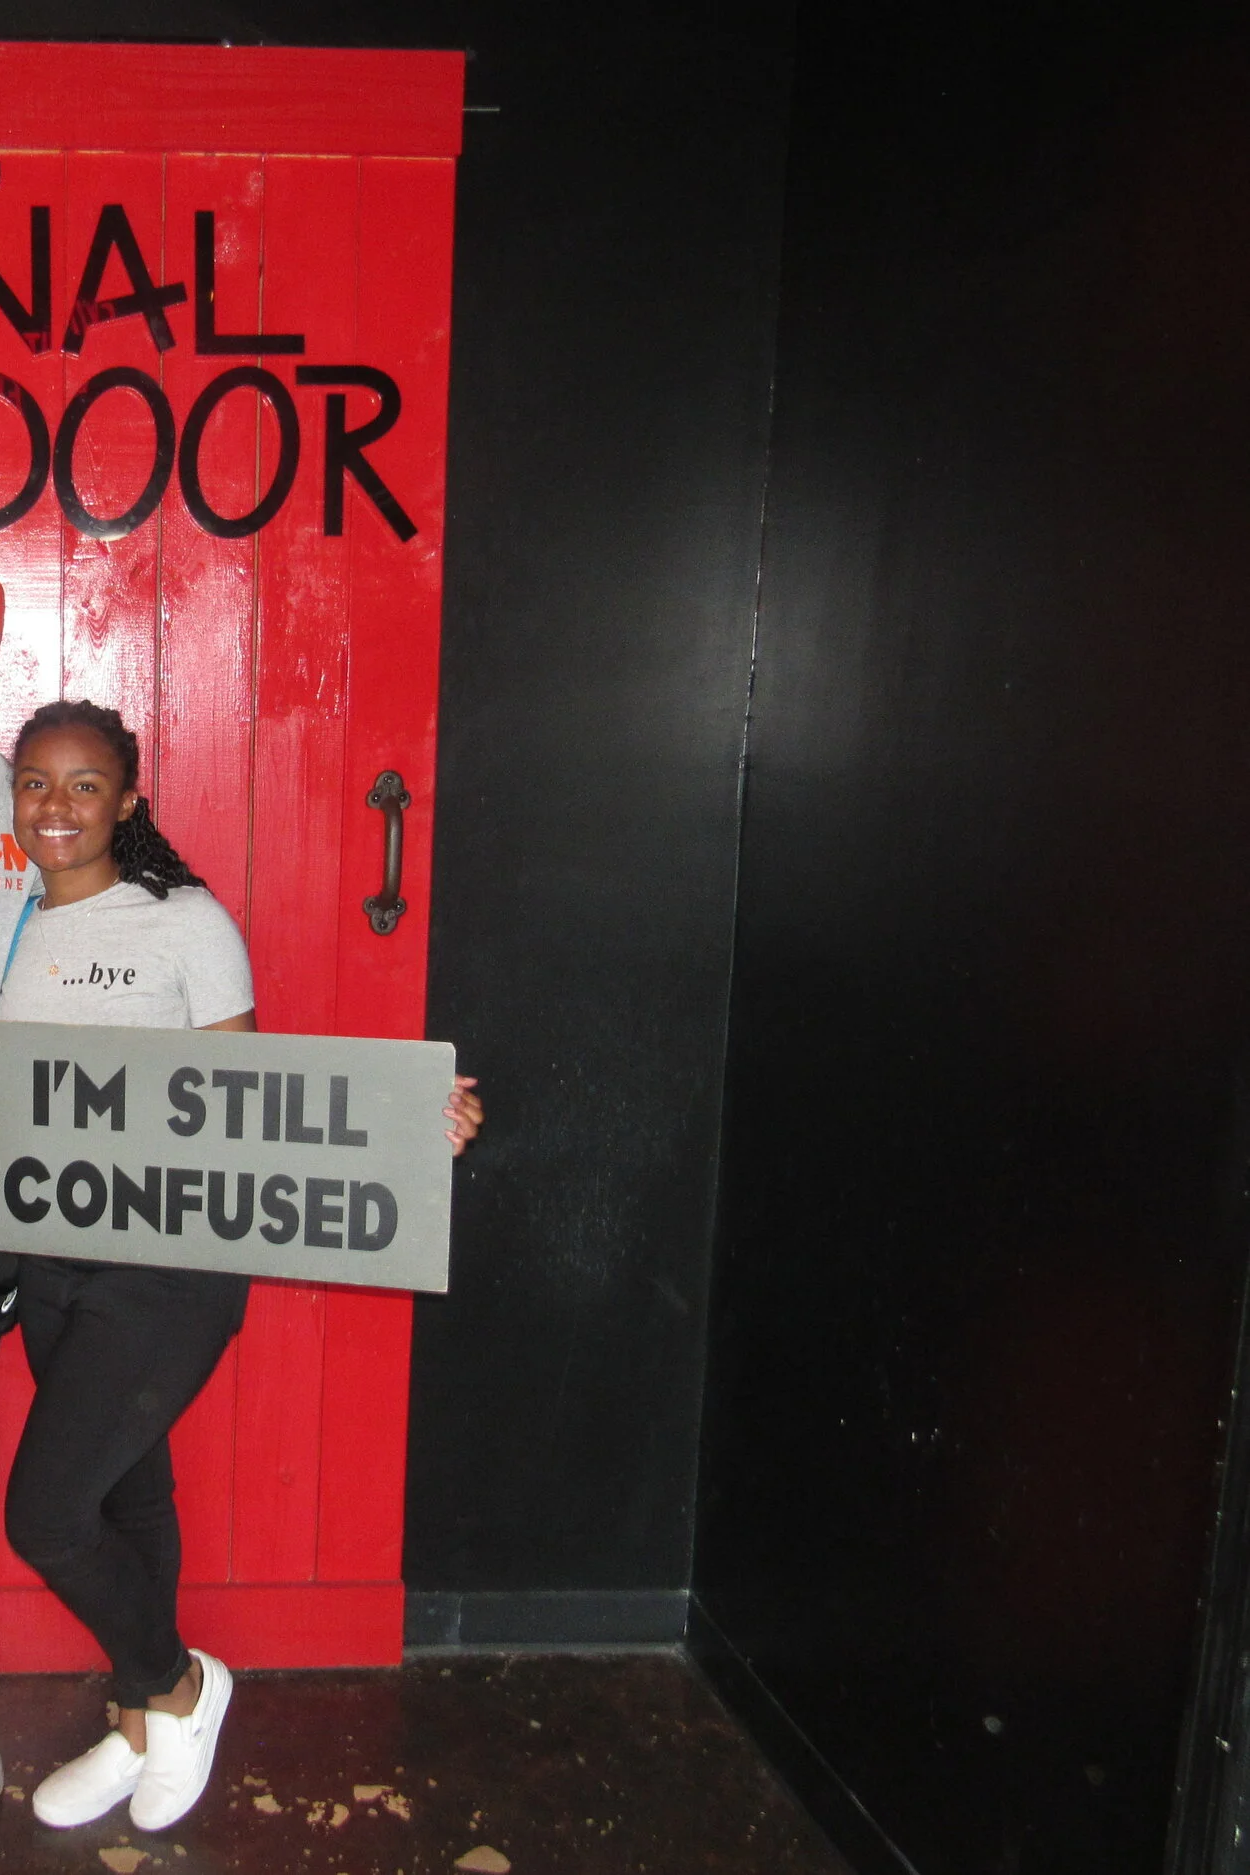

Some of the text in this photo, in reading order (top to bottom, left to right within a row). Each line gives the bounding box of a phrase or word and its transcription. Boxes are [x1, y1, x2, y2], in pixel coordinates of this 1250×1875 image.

[32, 1059, 368, 1147] I'M STILL
[3, 1156, 398, 1252] CONFUSED
